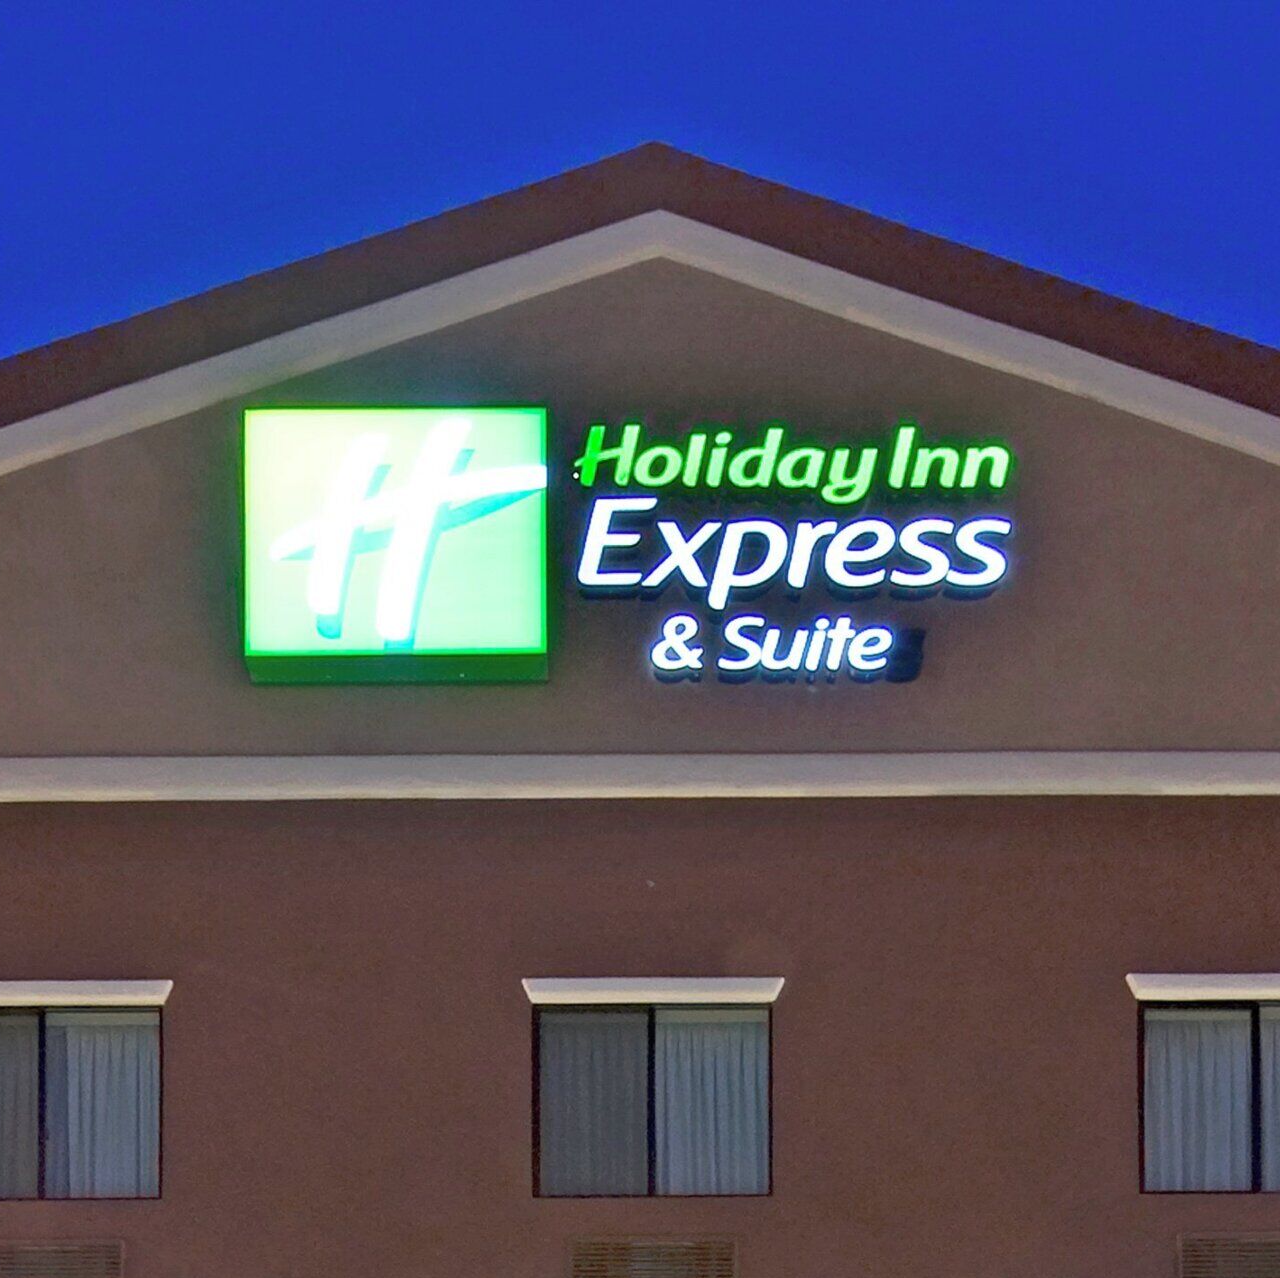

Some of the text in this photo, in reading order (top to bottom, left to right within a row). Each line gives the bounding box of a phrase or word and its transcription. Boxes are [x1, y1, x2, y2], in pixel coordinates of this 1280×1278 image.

[574, 424, 1010, 503] Holiday Inn
[577, 496, 1012, 610] Express
[651, 614, 704, 670] &
